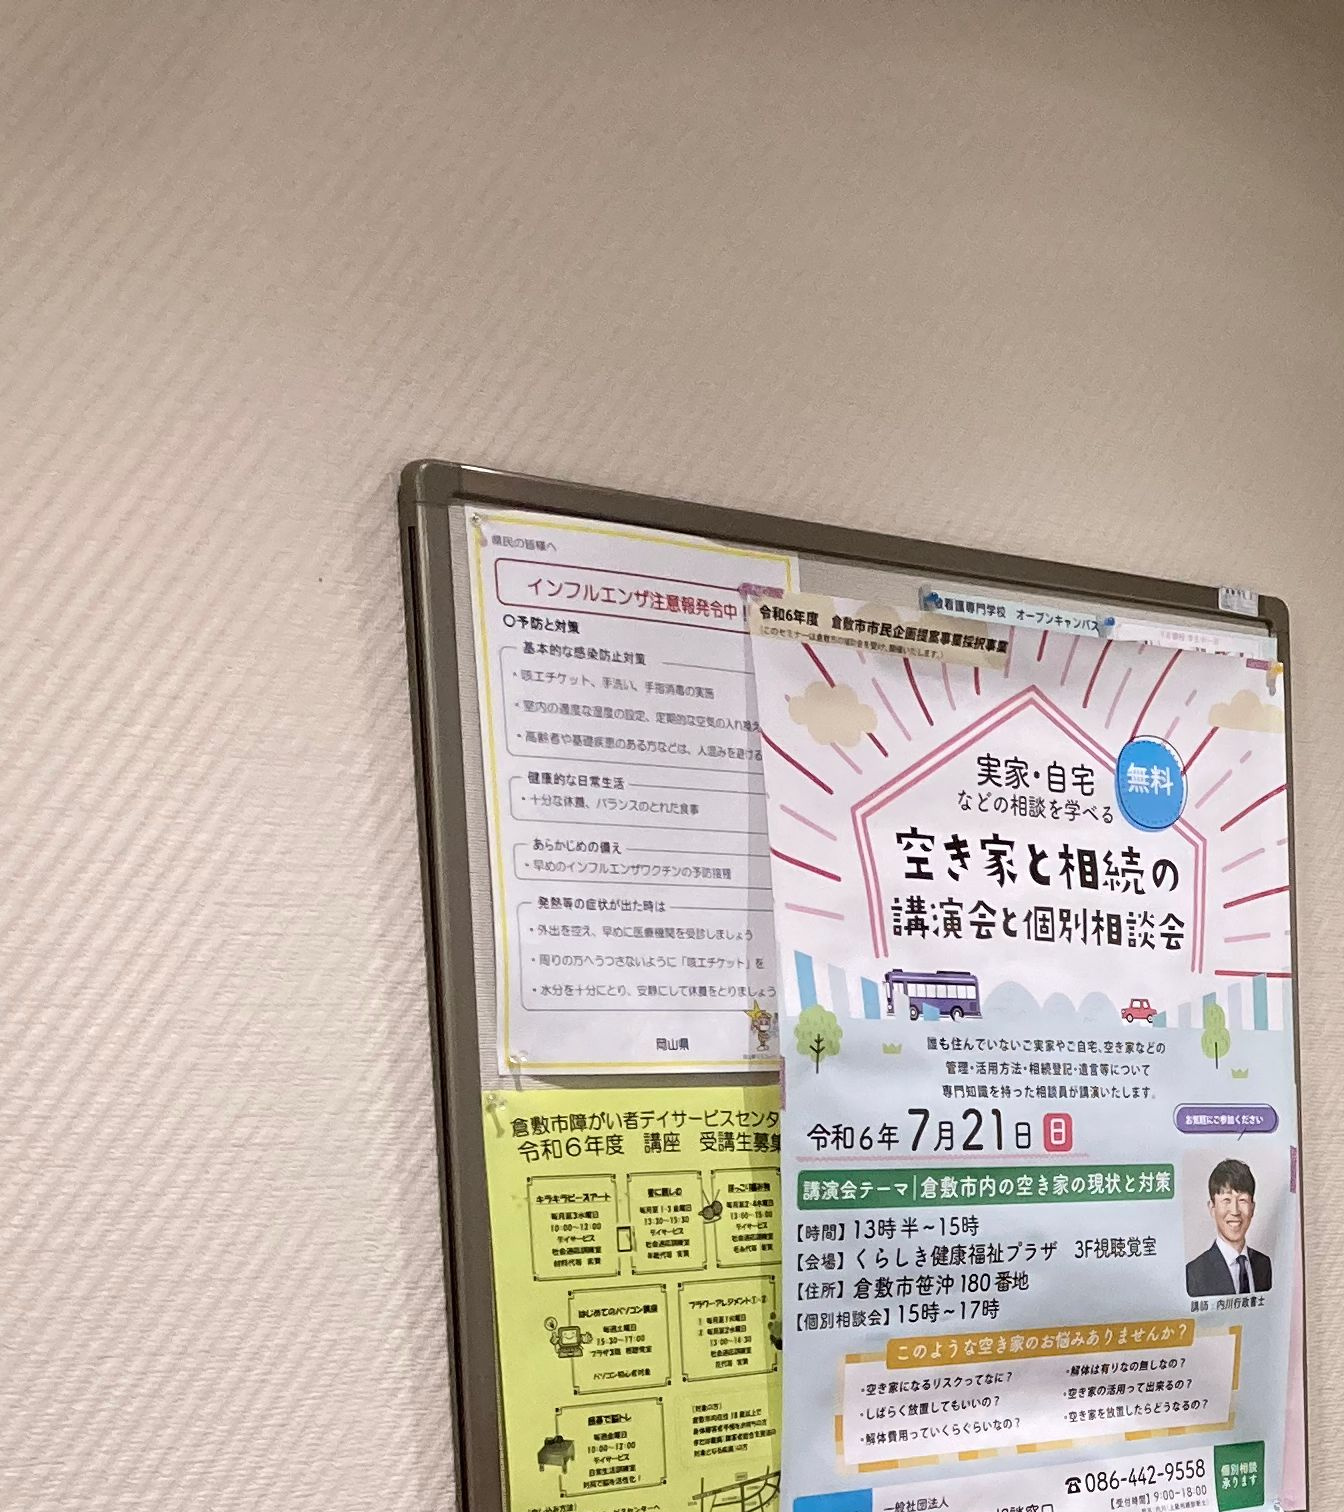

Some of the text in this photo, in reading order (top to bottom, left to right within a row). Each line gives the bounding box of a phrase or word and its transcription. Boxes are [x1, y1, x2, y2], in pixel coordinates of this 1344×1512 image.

[759, 605, 819, 627] 令和6年度
[522, 641, 646, 665] 基本的な感染防止対策
[527, 771, 625, 790] 健康的な日常生活
[975, 752, 1095, 797] 実家・自宅
[1126, 763, 1174, 796] 無料
[958, 789, 1114, 824] などの相談を学べる
[532, 838, 622, 855] あらかじめの備え
[895, 826, 1180, 896] 空き家と相続の
[537, 896, 666, 913] 発熱等の症状が出た時は
[890, 896, 1186, 952] 講演会と個別相談会
[655, 1037, 690, 1051] 岡山県
[643, 1131, 681, 1154] 講座
[855, 1241, 1058, 1270] くらしき健康福祉プラザ
[1074, 1236, 1158, 1260] 3F視聴覚室
[897, 1323, 1187, 1361] このような空き家のお悩みありませんか？
[1085, 1458, 1206, 1493] 086-442-9558
[1221, 1461, 1258, 1477] 個別相談
[1221, 1475, 1258, 1491] 承ります
